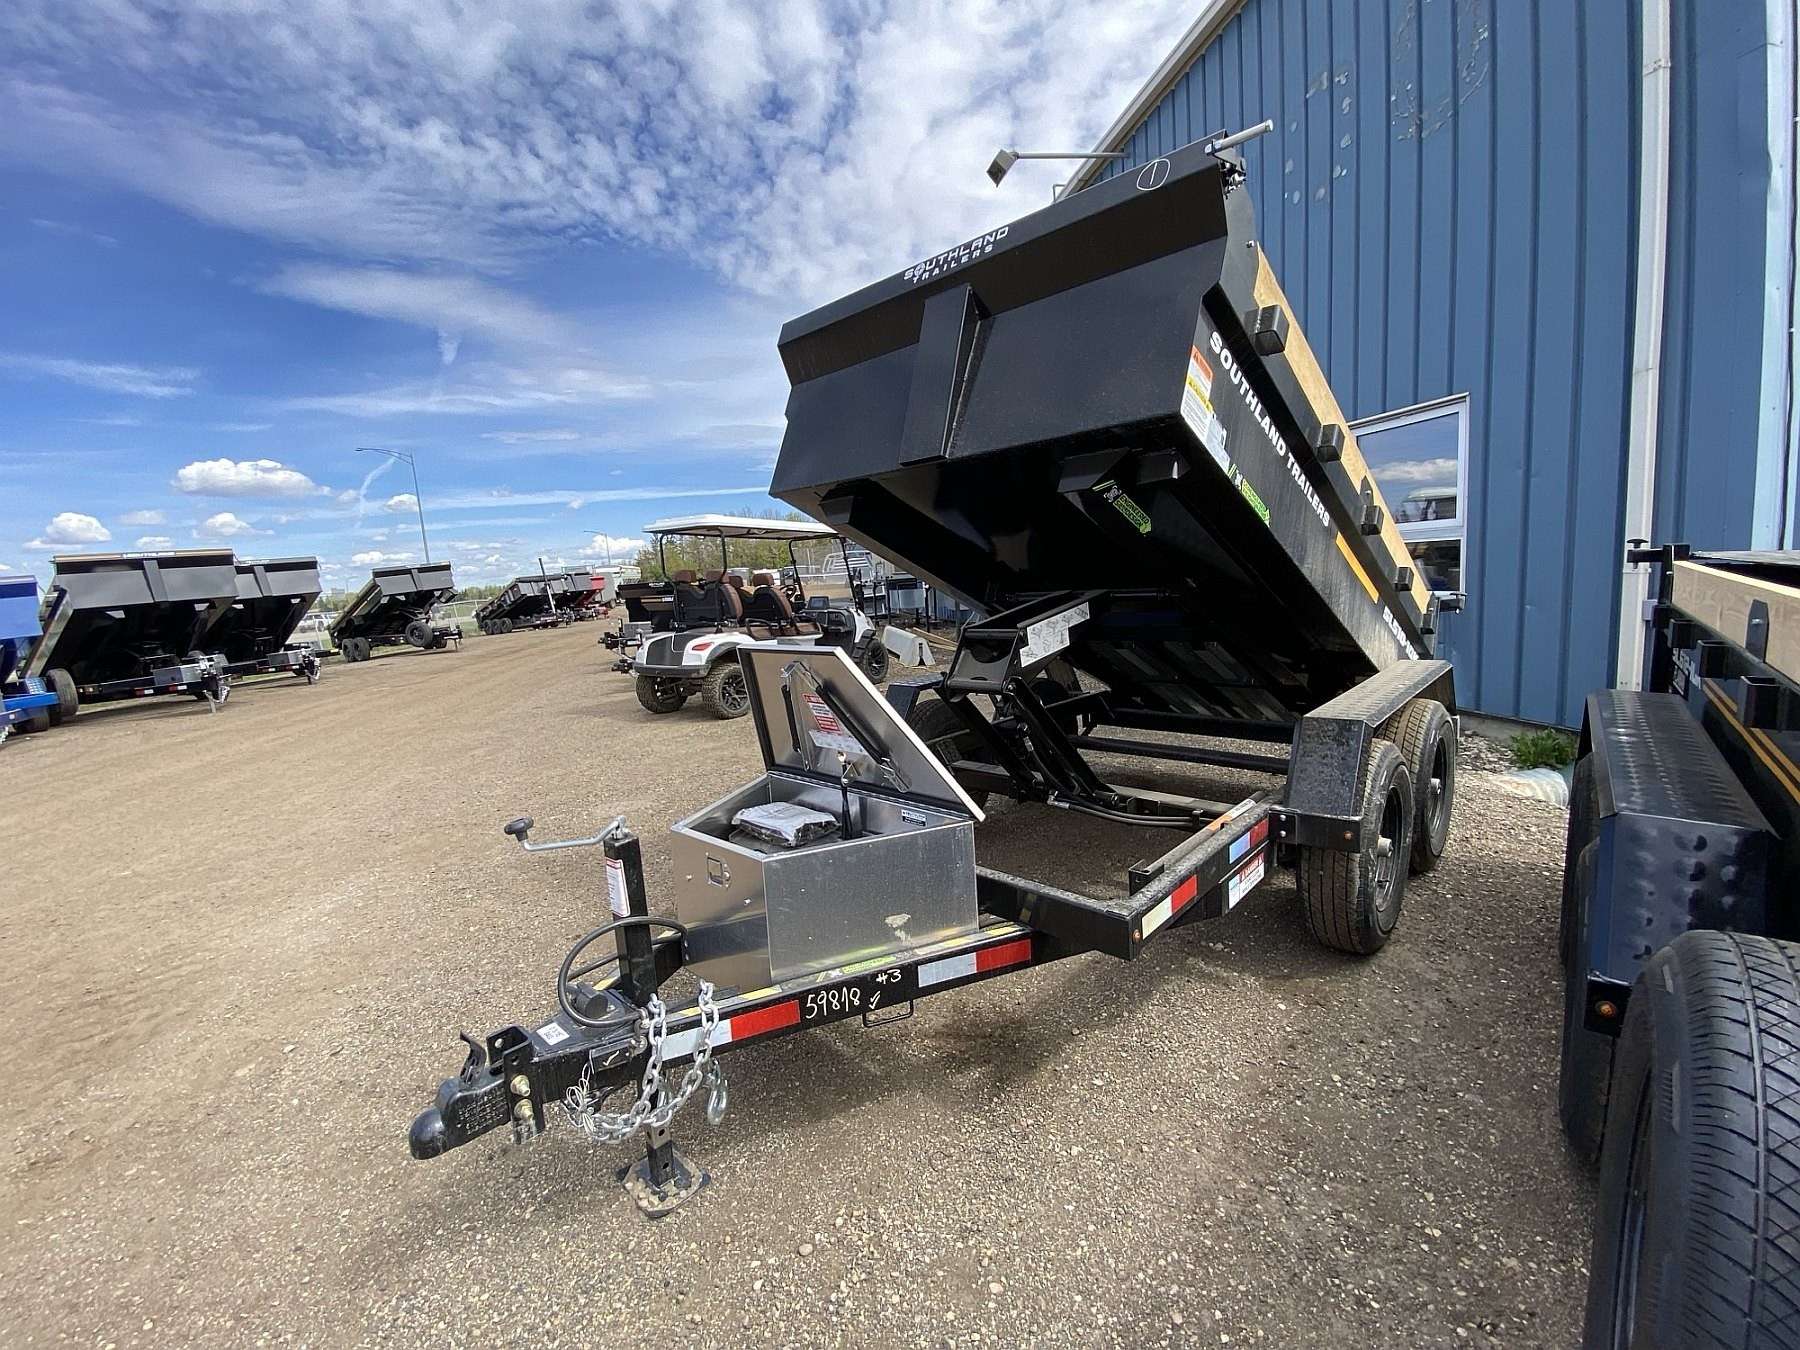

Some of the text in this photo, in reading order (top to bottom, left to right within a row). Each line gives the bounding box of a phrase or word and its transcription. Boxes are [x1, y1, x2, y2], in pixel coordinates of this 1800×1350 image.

[903, 226, 1009, 280] SOUTHLAND
[912, 243, 994, 284] TRAILERS
[1209, 331, 1287, 457] SOUTHLAND
[1286, 452, 1332, 527] TRAILERS
[875, 968, 902, 985] #3
